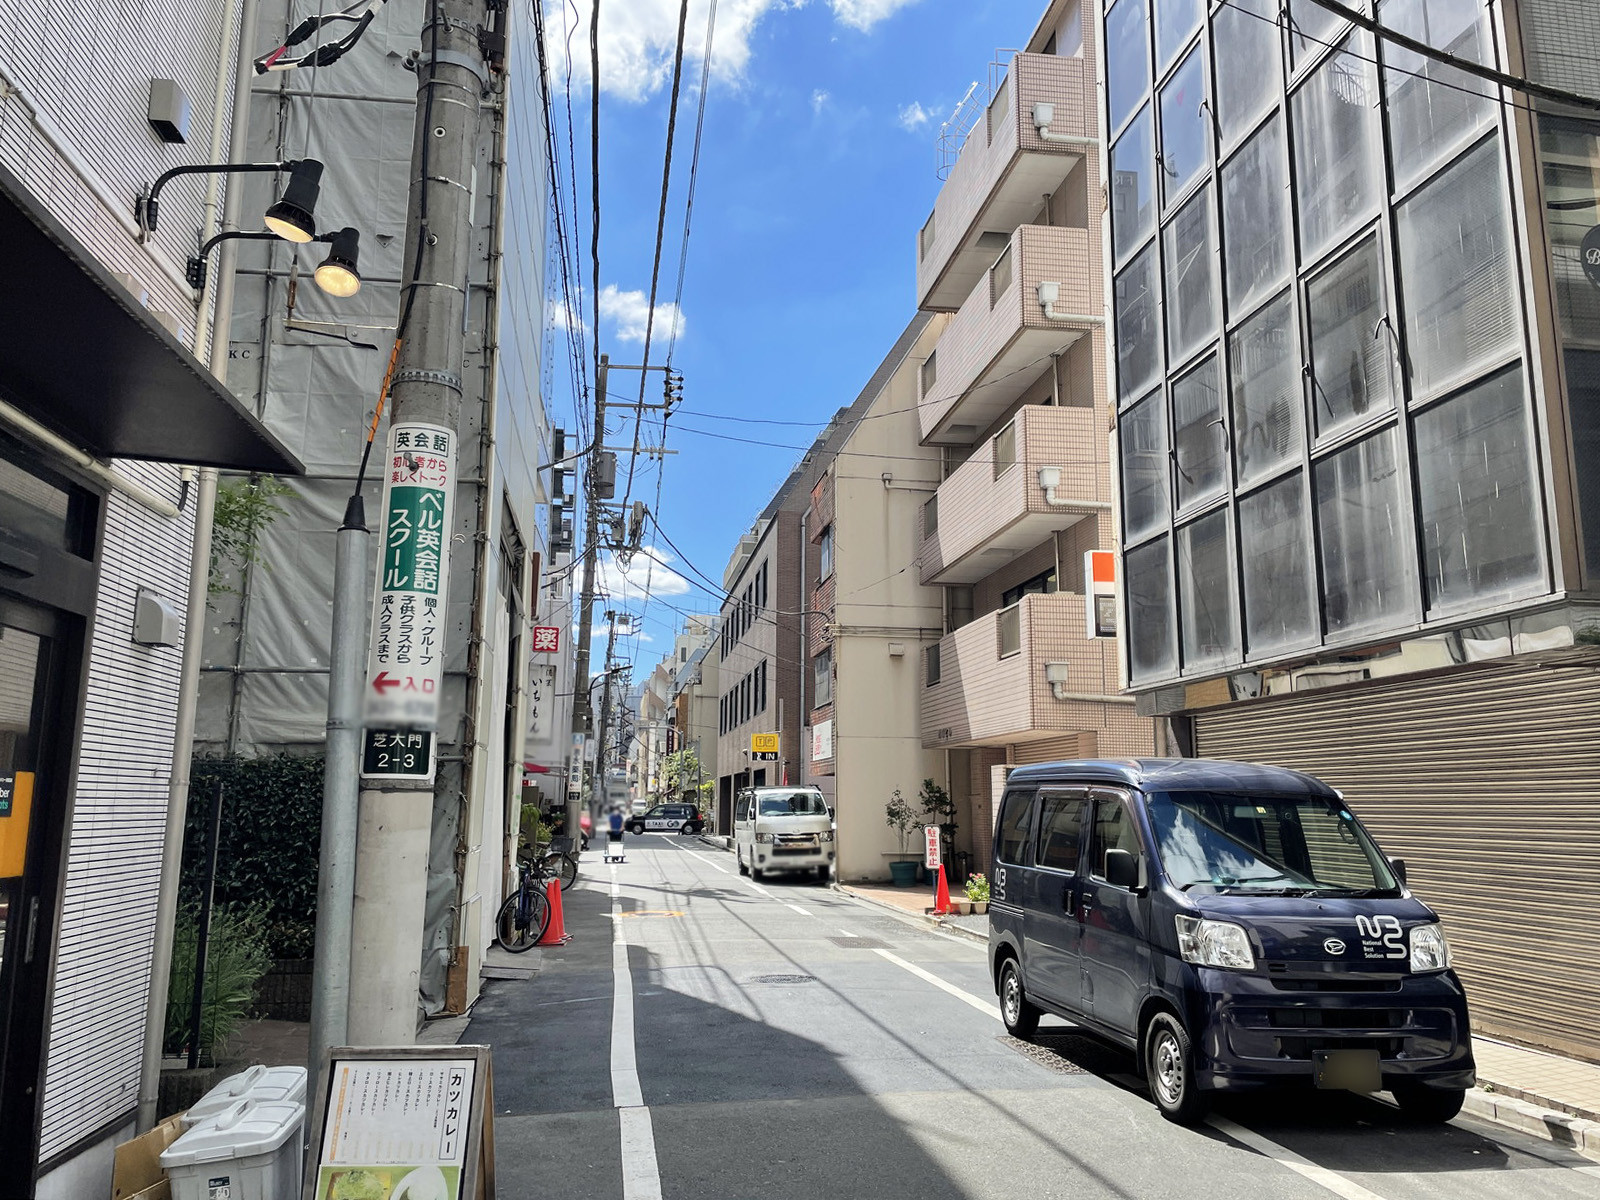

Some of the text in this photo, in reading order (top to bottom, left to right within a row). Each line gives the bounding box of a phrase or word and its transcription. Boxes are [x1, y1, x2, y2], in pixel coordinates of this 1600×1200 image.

[397, 431, 447, 453] 英会話
[391, 471, 447, 487] 楽しくトーク
[384, 509, 412, 588] スクール
[413, 492, 443, 591] ベル英会話
[377, 595, 394, 663] 成人クラスまで
[397, 595, 416, 664] 子供クラスから
[419, 597, 437, 665] 個人・グループ
[534, 628, 557, 650] 薬
[403, 677, 434, 693] 入口
[373, 733, 422, 749] 芝大門
[377, 753, 415, 768] 2-3
[765, 752, 775, 760] IN
[666, 820, 680, 828] GO
[926, 828, 938, 867] 駐車禁止
[446, 1073, 463, 1154] カツカレー
